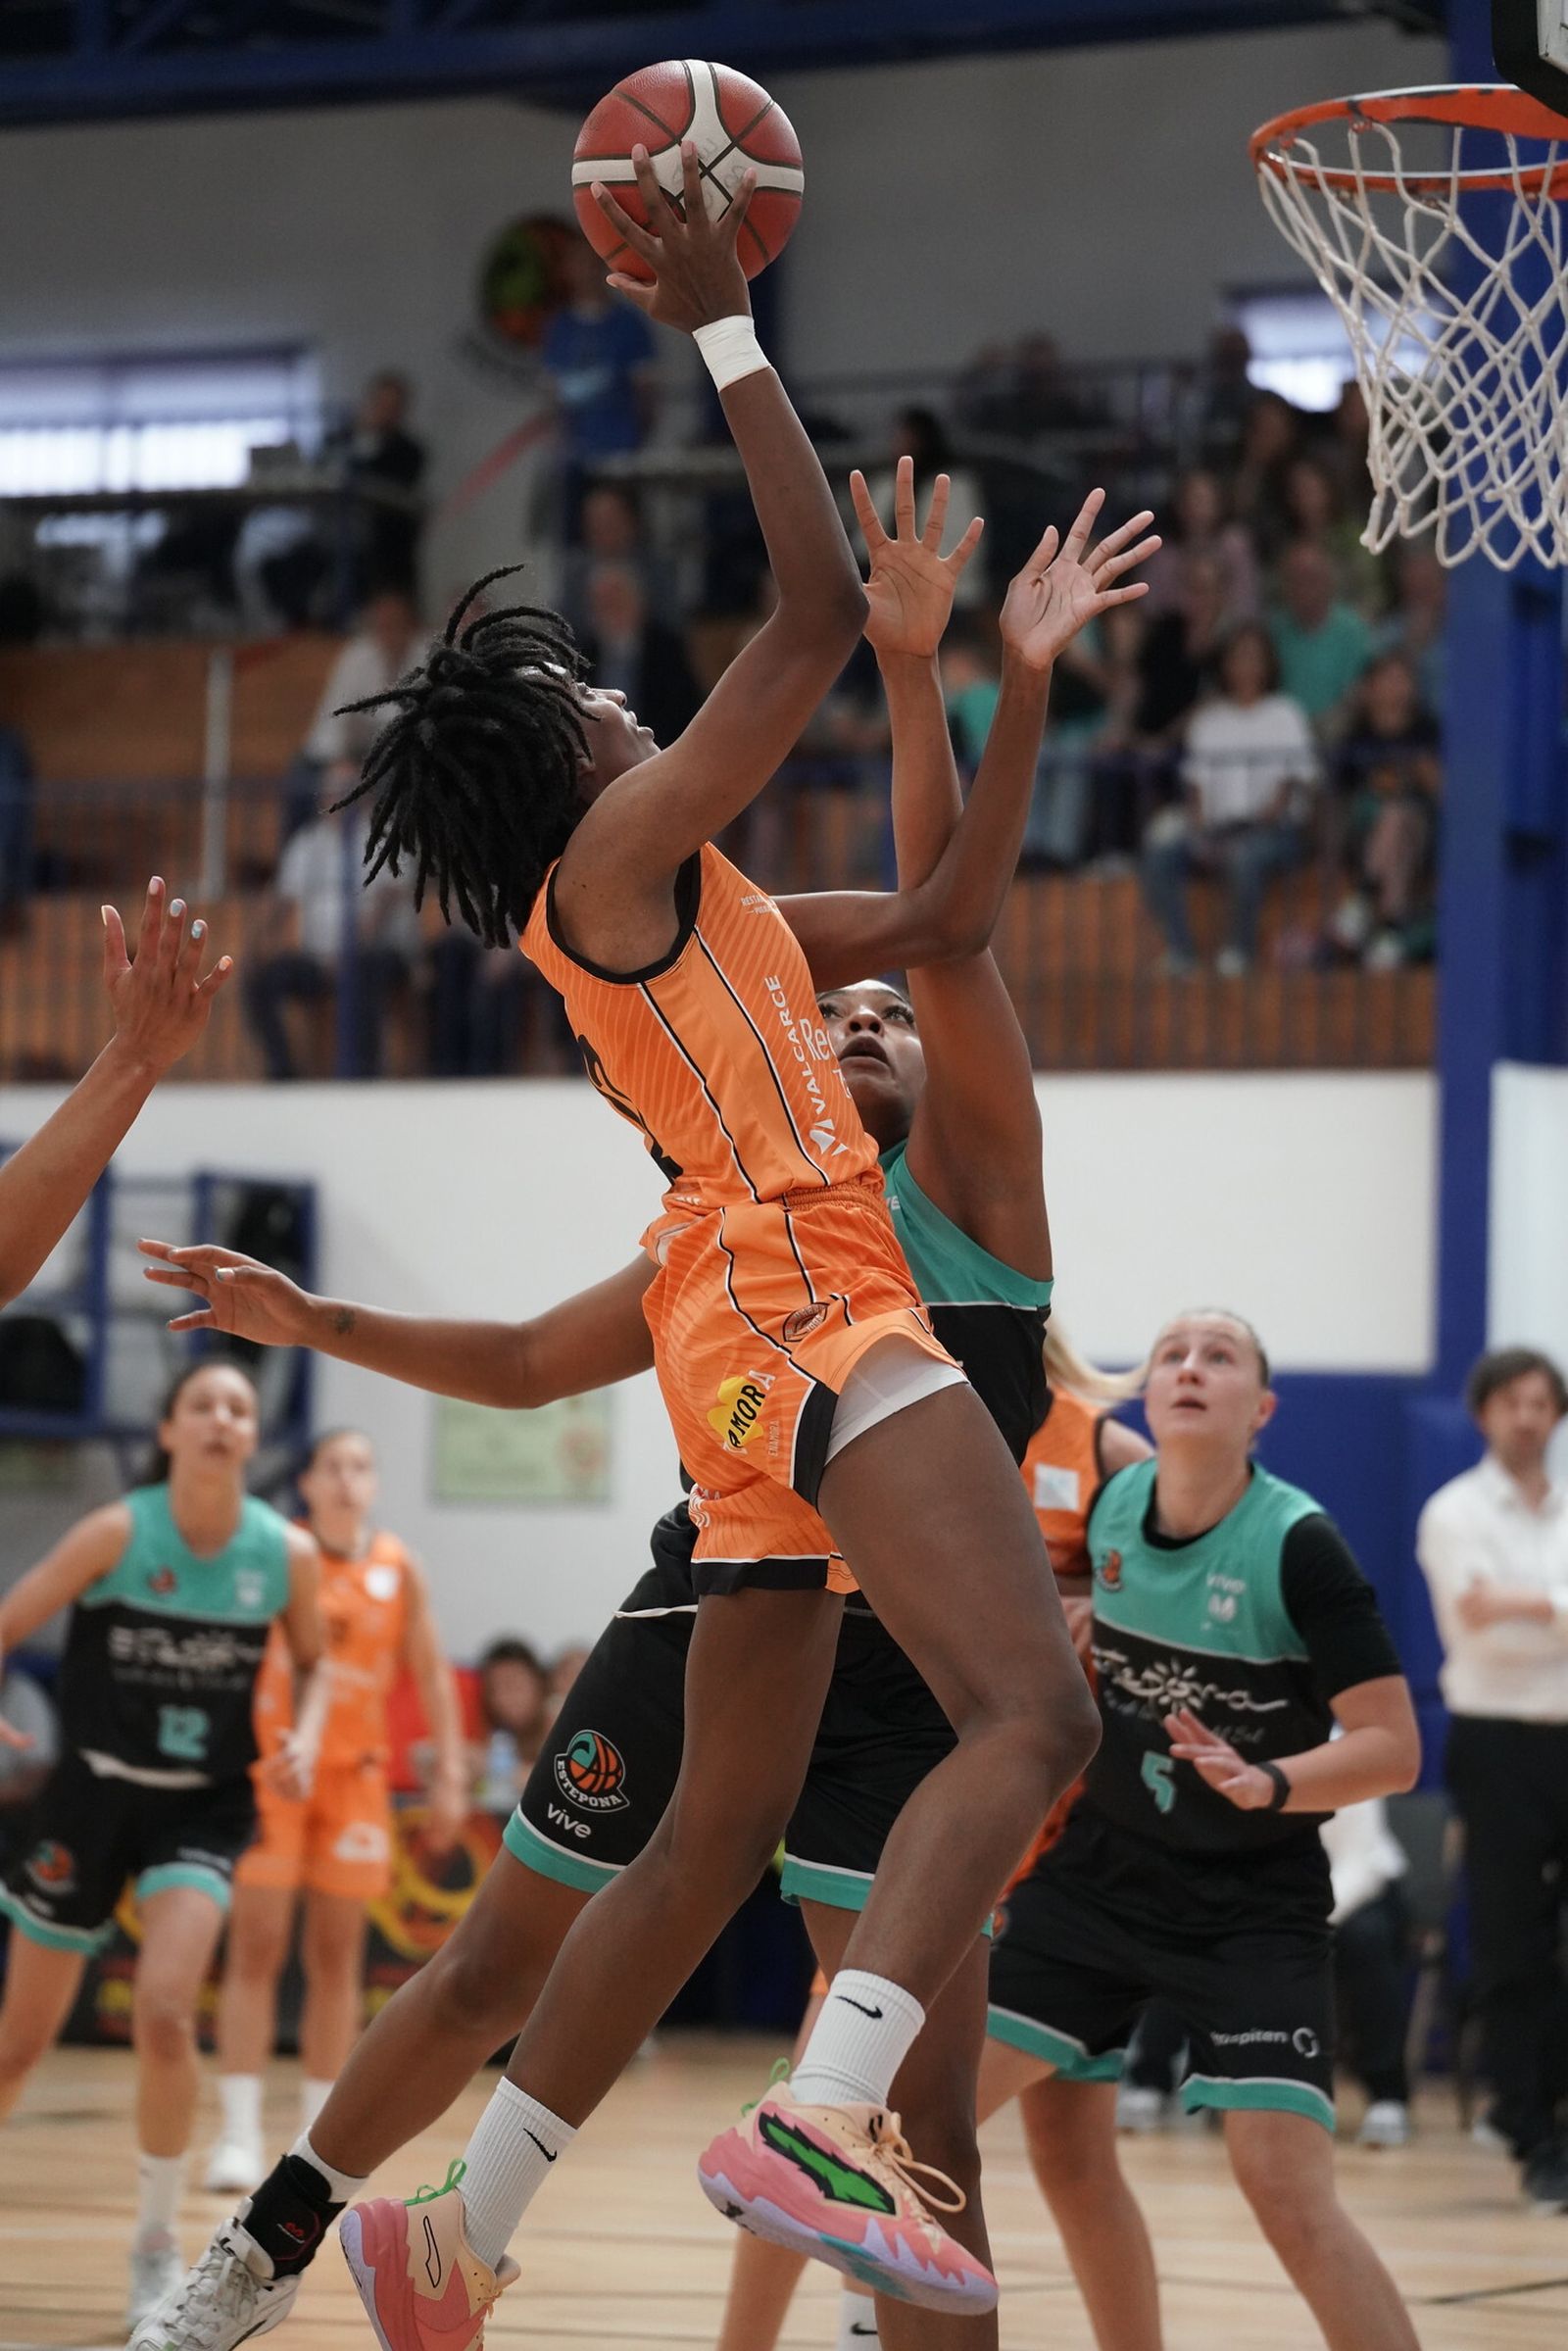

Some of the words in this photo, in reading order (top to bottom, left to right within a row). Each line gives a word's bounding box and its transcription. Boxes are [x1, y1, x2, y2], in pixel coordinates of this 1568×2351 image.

[764, 974, 826, 1115] VALCARCE
[557, 1760, 622, 1808] ESTEPONA
[546, 1803, 592, 1838] vive
